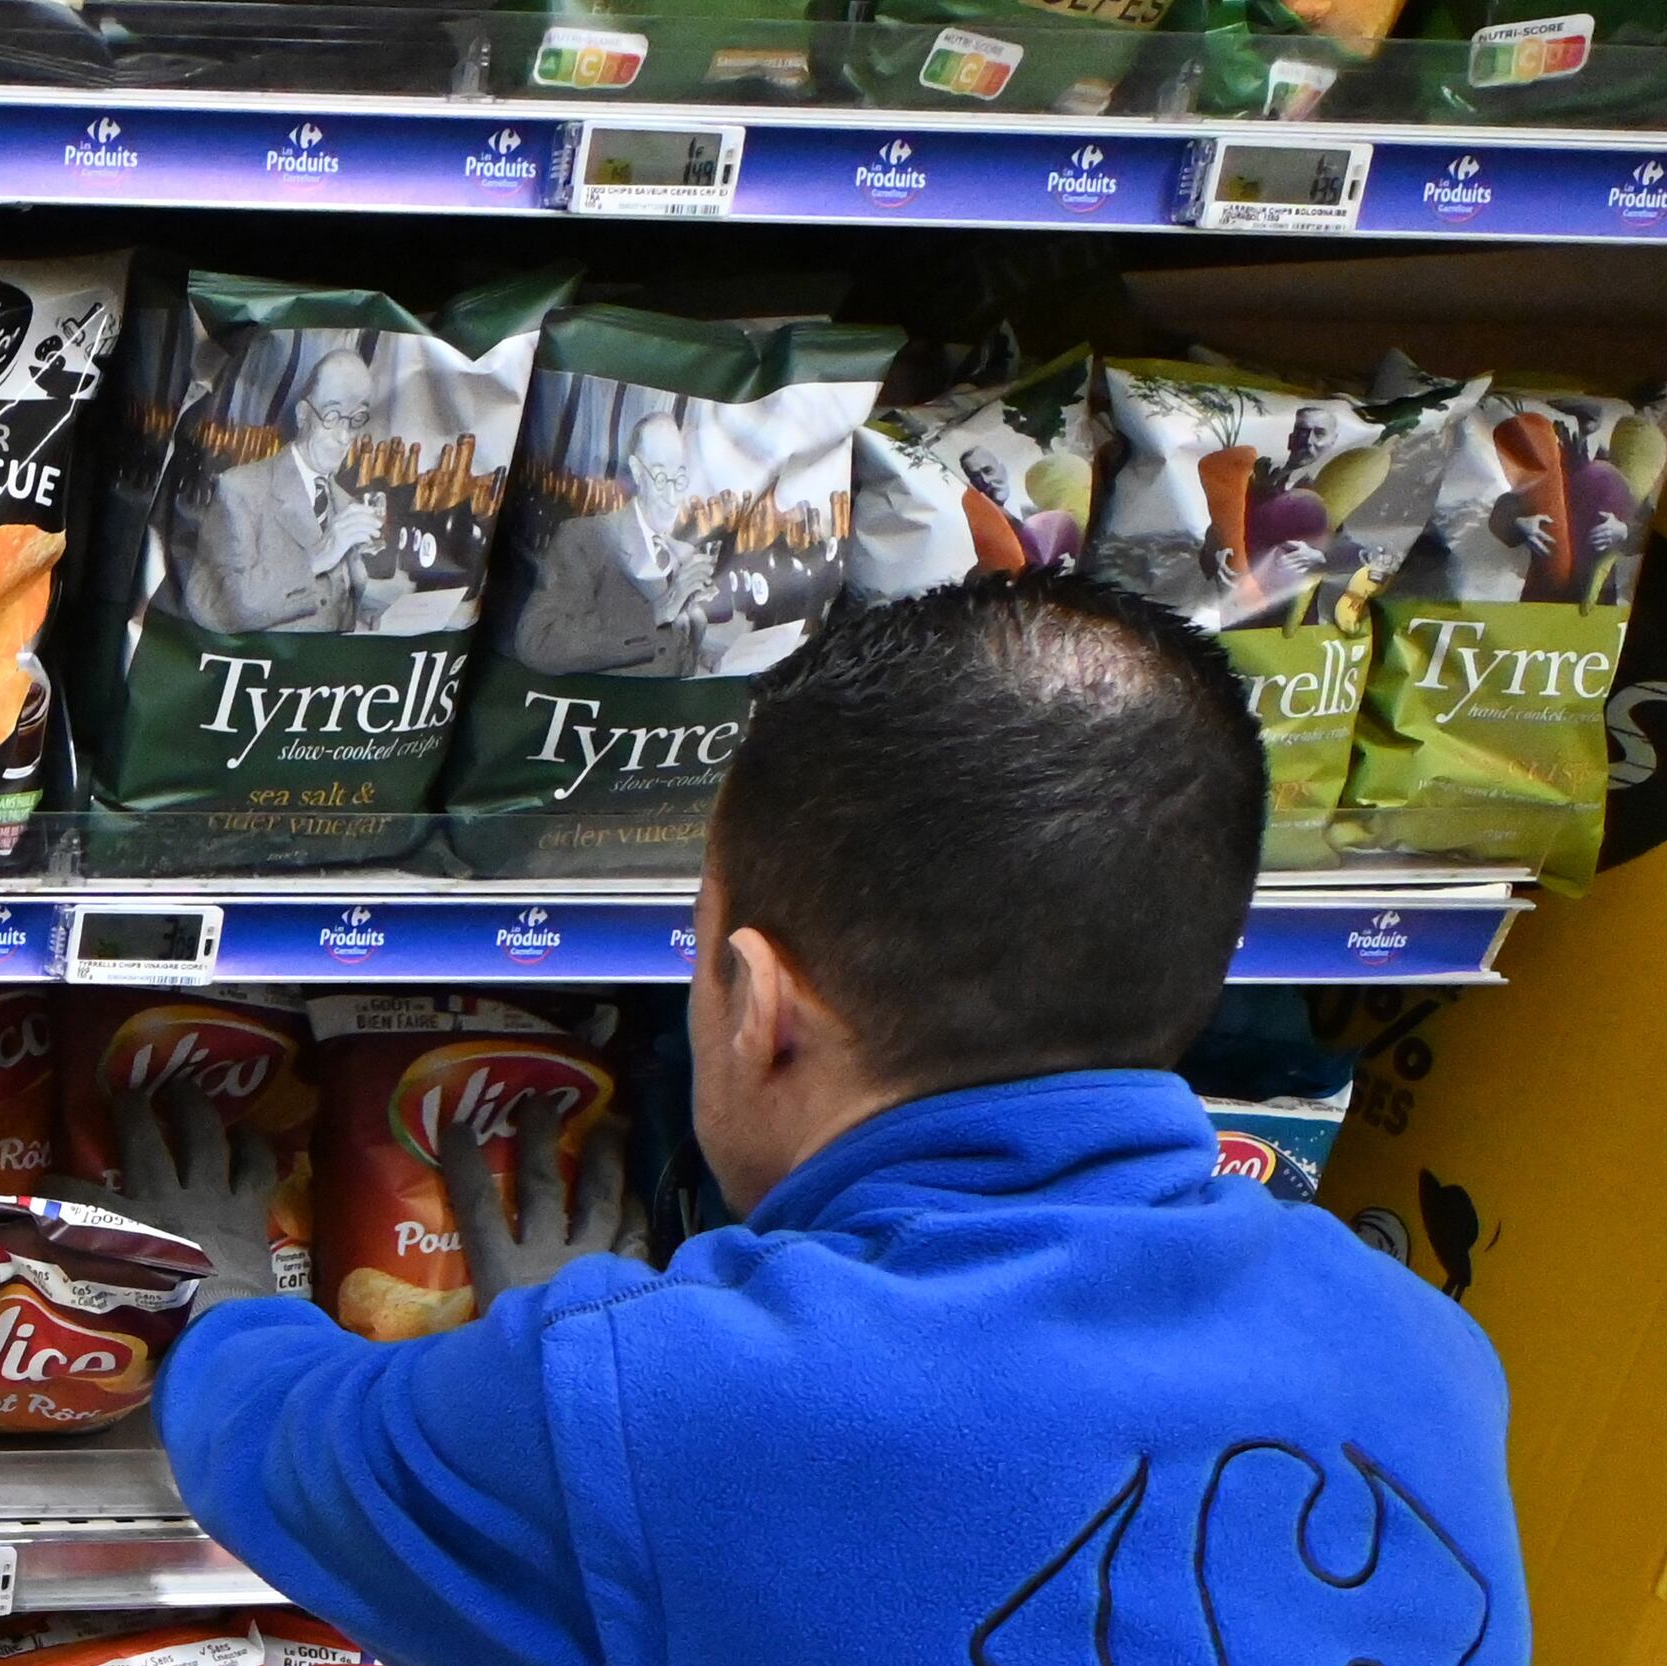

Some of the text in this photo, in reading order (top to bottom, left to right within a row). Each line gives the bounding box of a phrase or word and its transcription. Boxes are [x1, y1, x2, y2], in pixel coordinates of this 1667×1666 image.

[266, 149, 339, 176] Produits
[1423, 180, 1492, 207] Produits
[278, 739, 394, 761] slow-cooked
[526, 691, 739, 800] Tyrre
[248, 781, 376, 806] sea salt &
[1347, 930, 1407, 950] Produits
